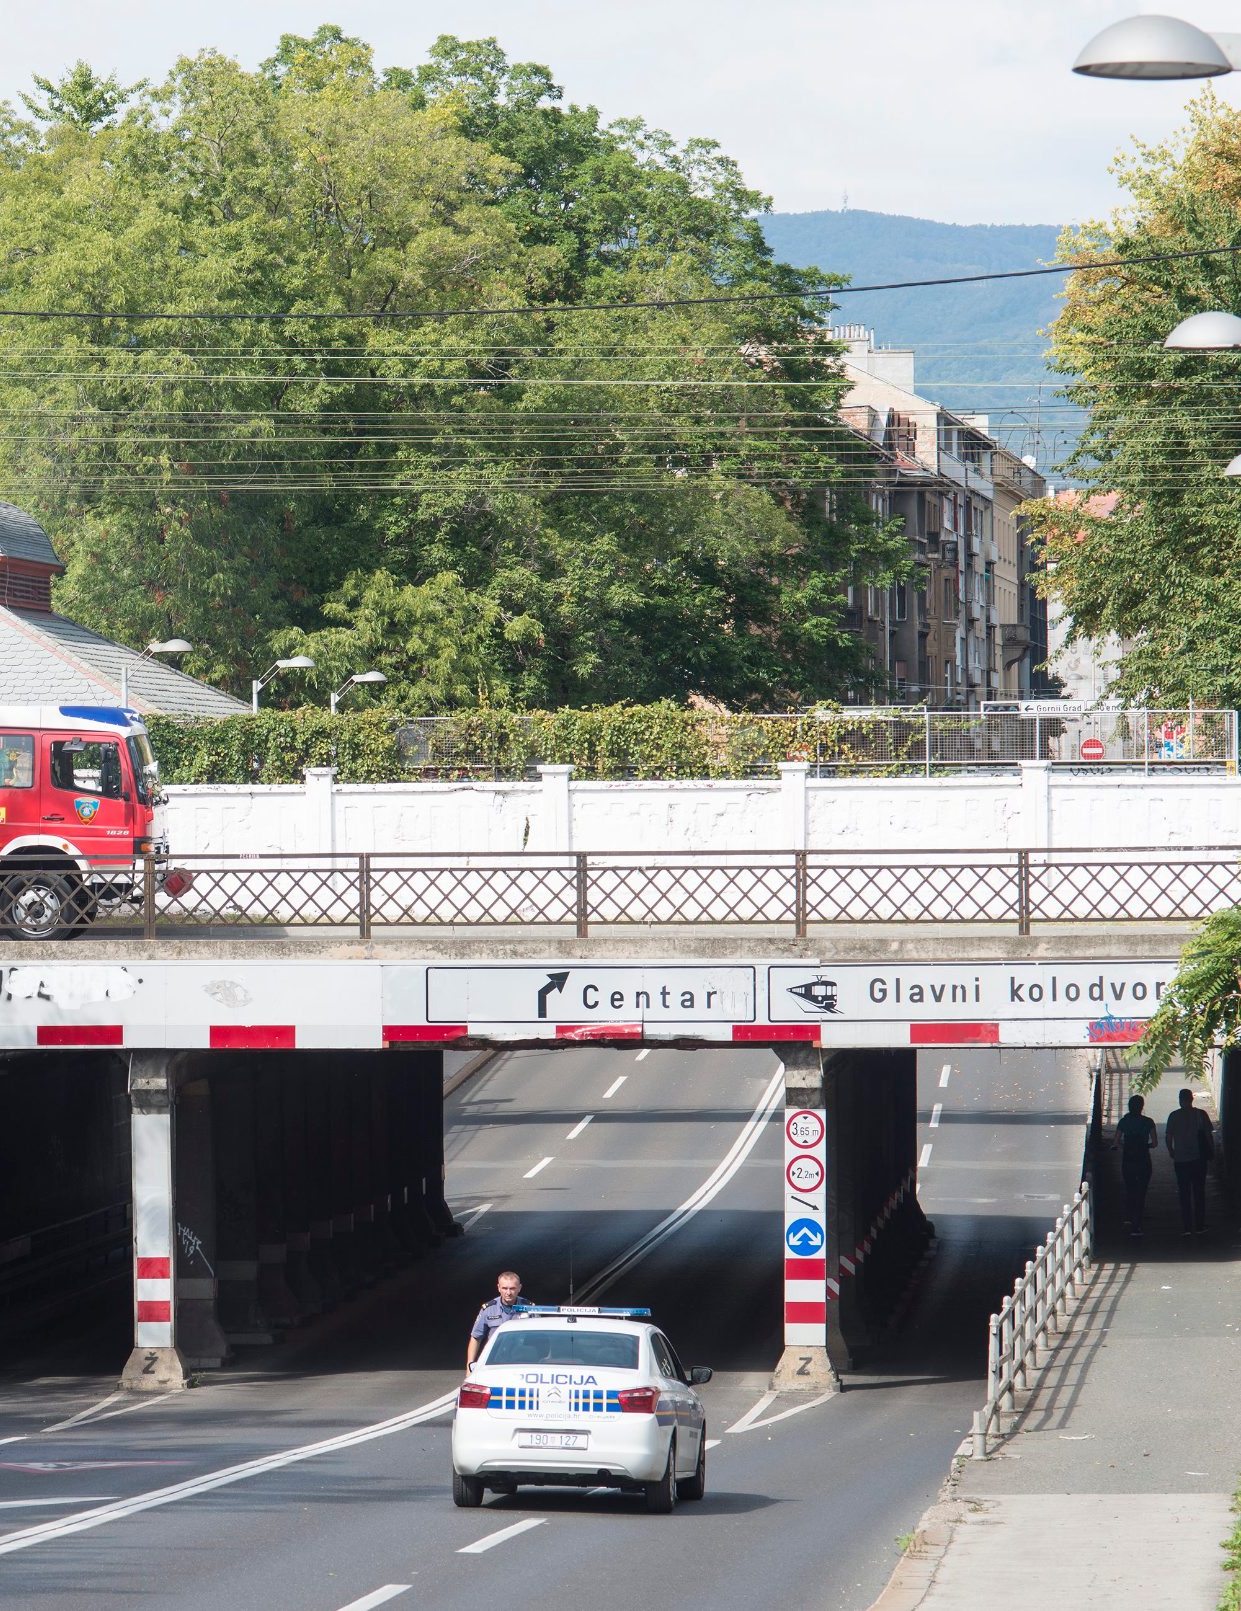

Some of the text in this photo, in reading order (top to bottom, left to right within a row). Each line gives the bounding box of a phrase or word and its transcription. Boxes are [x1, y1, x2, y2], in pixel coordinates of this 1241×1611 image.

[1063, 704, 1082, 712] Grad
[582, 984, 718, 1010] Centar
[869, 975, 1166, 1004] Glavni kolodvor
[142, 1351, 159, 1375] Ž
[796, 1356, 813, 1376] Z
[530, 1434, 578, 1446] 190 127
